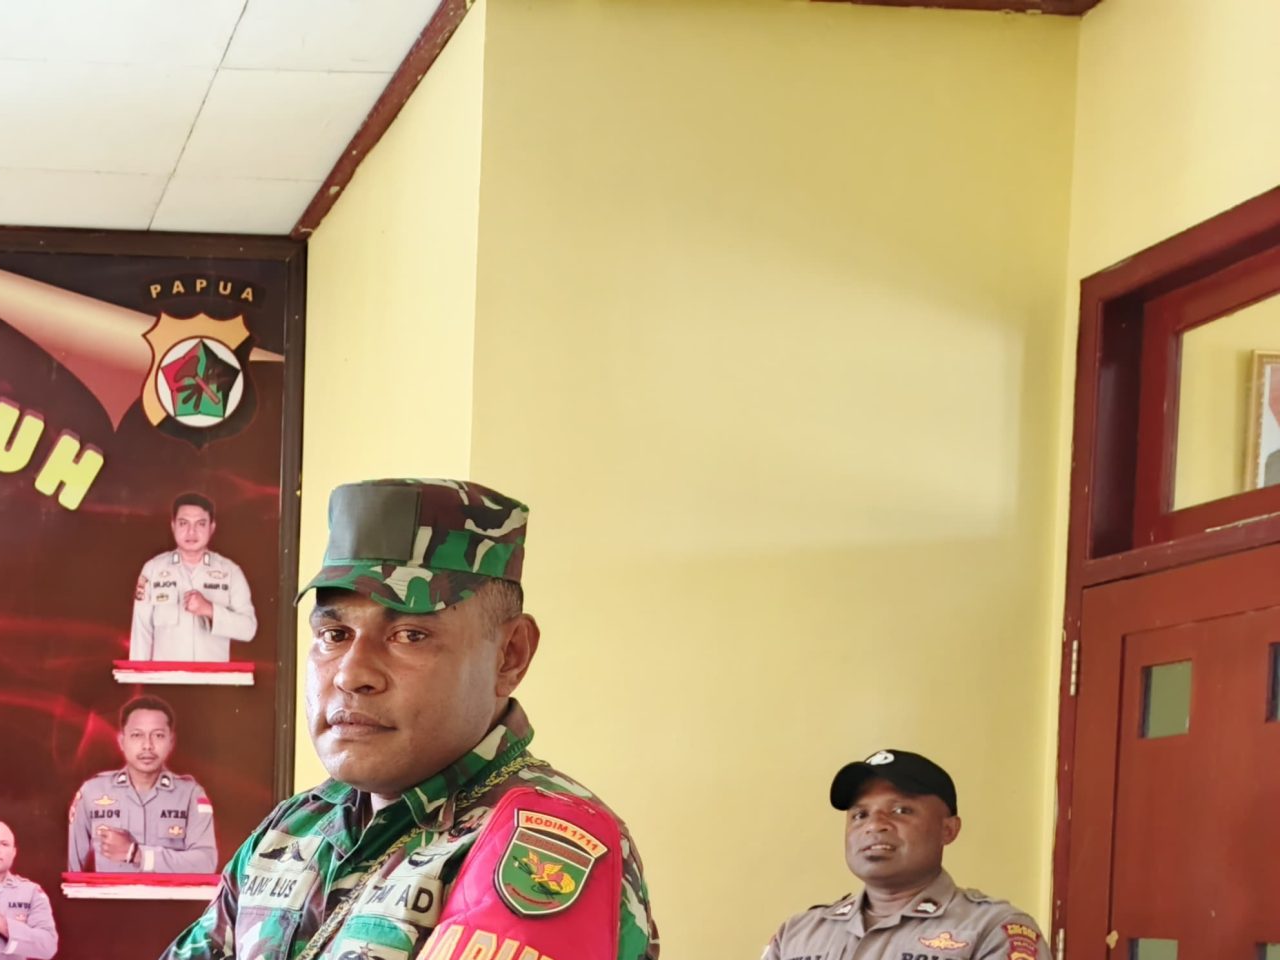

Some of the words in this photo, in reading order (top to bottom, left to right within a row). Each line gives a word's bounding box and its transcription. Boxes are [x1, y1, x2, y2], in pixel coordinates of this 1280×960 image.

[149, 279, 254, 302] PAPUA
[524, 815, 569, 832] KODIM
[568, 829, 599, 852] 1711
[395, 884, 434, 913] AD
